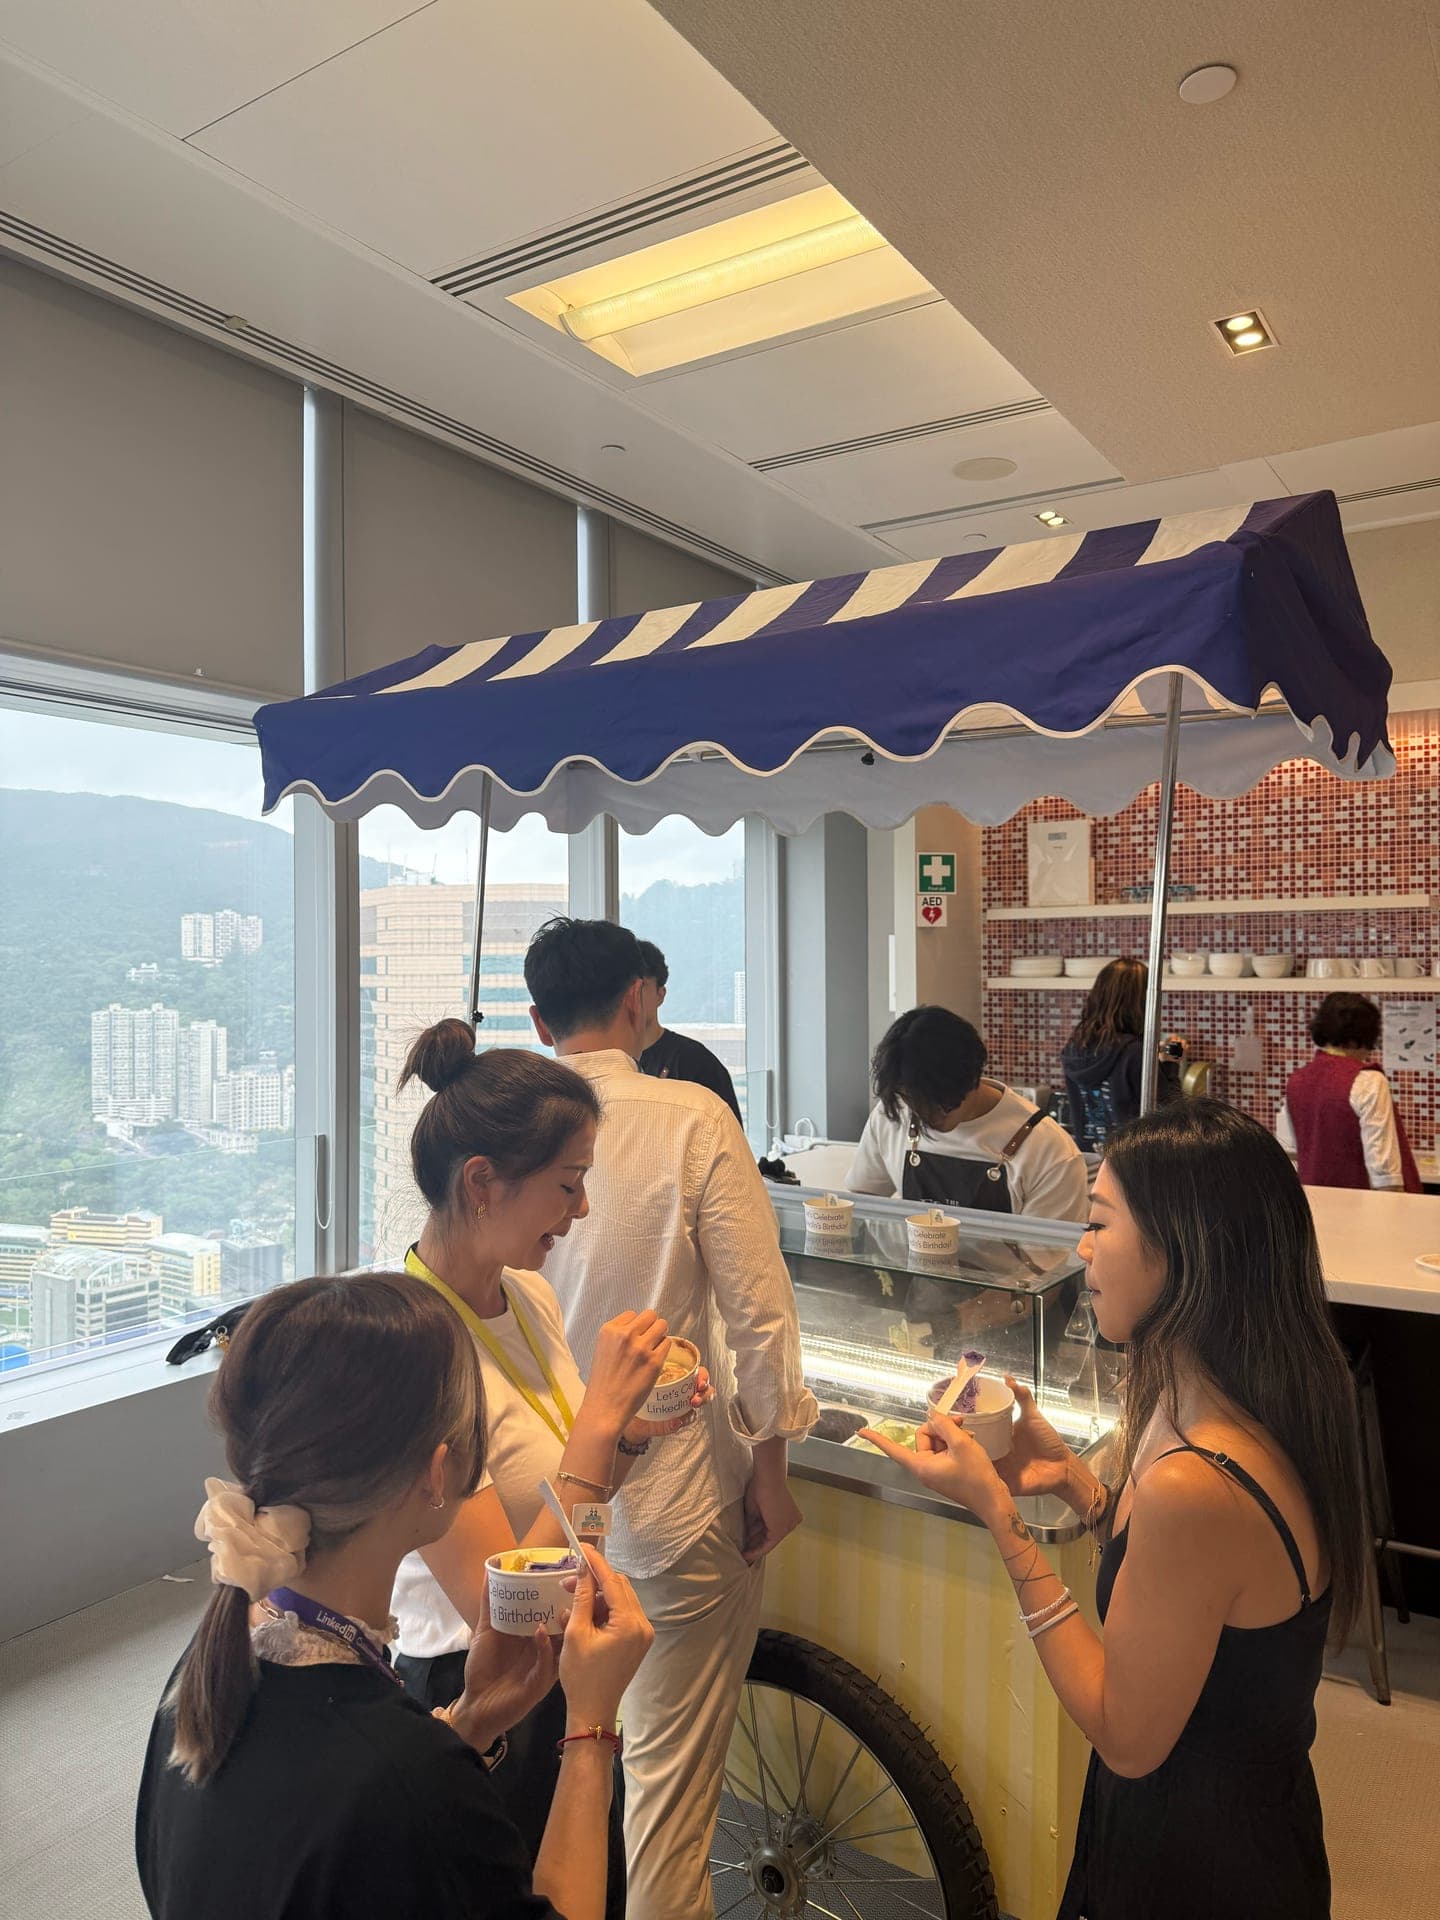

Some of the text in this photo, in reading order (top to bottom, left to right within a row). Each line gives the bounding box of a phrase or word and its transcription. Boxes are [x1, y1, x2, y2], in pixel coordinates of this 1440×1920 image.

[922, 897, 942, 906] AED
[814, 1212, 844, 1220] Celebrate
[914, 1230, 946, 1239] Celebrate
[656, 1388, 679, 1401] Let's
[498, 1604, 555, 1625] Birthday!
[316, 1610, 358, 1641] LinkedIn
